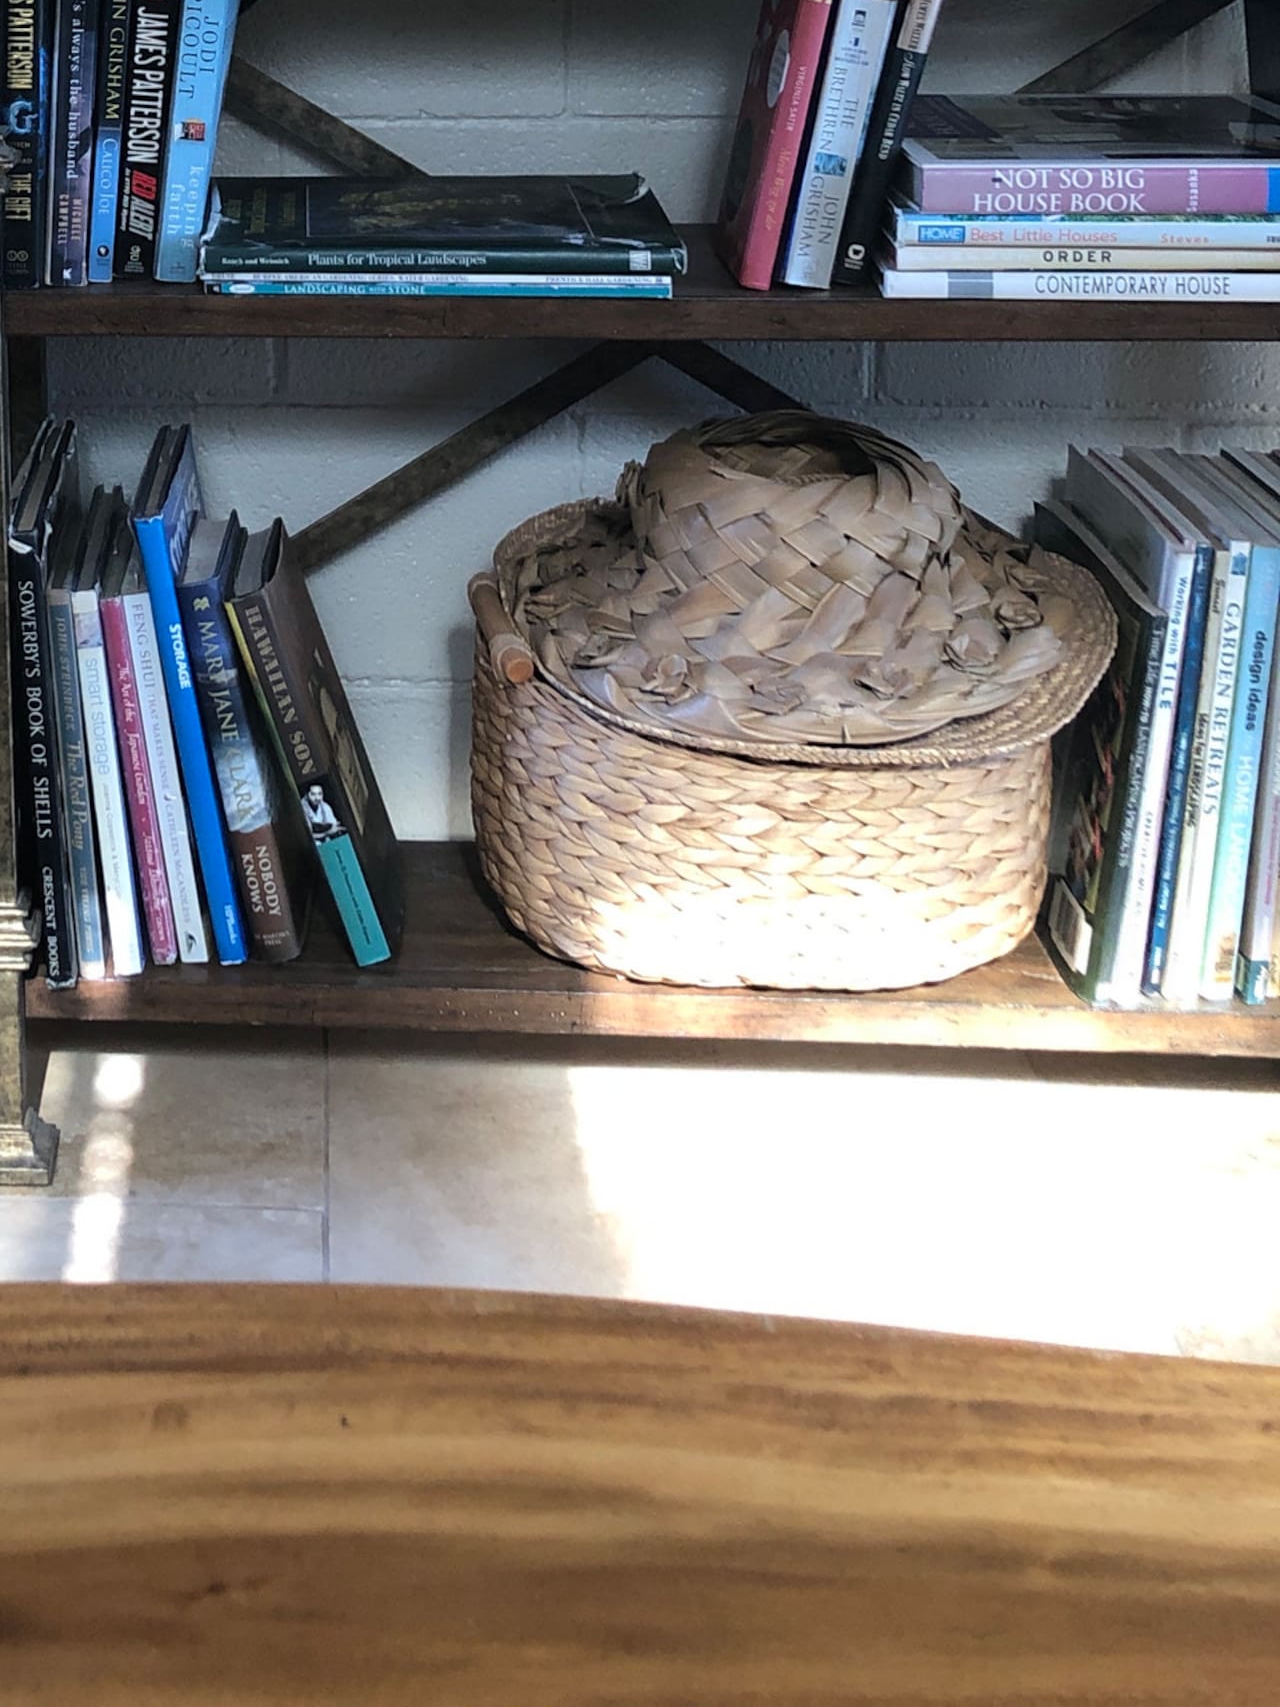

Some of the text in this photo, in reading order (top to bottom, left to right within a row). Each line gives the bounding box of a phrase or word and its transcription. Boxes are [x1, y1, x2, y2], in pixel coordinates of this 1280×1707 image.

[7, 8, 34, 90] PATTERSON
[68, 18, 85, 72] always
[199, 14, 220, 74] JODI
[68, 78, 82, 105] the
[104, 27, 126, 120] GRISHAM
[126, 5, 169, 164] JAMES PATTERSON
[819, 66, 848, 152] BRETHREN
[840, 97, 859, 128] THE
[65, 111, 81, 180] husband
[7, 172, 32, 194] THE
[98, 137, 118, 215] CALICO JOE
[973, 192, 1147, 212] HOUSE BOOK
[993, 168, 1145, 189] NOT SO BIG
[128, 195, 156, 241] ALERT
[167, 183, 185, 235] faith
[183, 165, 205, 248] keeping
[797, 175, 824, 257] GRISHAM
[817, 195, 840, 245] JOHN
[308, 252, 487, 268] Plants for Tropical Landscapes
[919, 227, 1118, 243] HOME Best Little Houses
[1042, 250, 1112, 263] ORDER
[284, 283, 366, 294] LANDSCAPING
[1034, 274, 1231, 296] CONTEMPORARY HOUSE
[131, 603, 149, 646] FENG
[1159, 575, 1189, 709] Working with TILE
[139, 650, 155, 690] SHUI
[169, 622, 192, 690] STORAGE
[1247, 630, 1268, 685] design
[59, 655, 77, 732] STEINBECK
[84, 658, 111, 776] smart storage
[244, 604, 317, 776] HAWAIIAN SON
[1202, 602, 1240, 816] GARDEN RETREATS
[1245, 688, 1263, 732] ideas
[197, 620, 258, 824] MARY JANE CLARK
[17, 580, 61, 978] SOWERBY'S BOOK OF SHELLS CRESCENT BOOKS
[67, 740, 83, 773] The
[69, 774, 86, 808] Red
[70, 809, 88, 851] Pony
[241, 853, 265, 914] KNOWS
[256, 845, 283, 917] NOBODY
